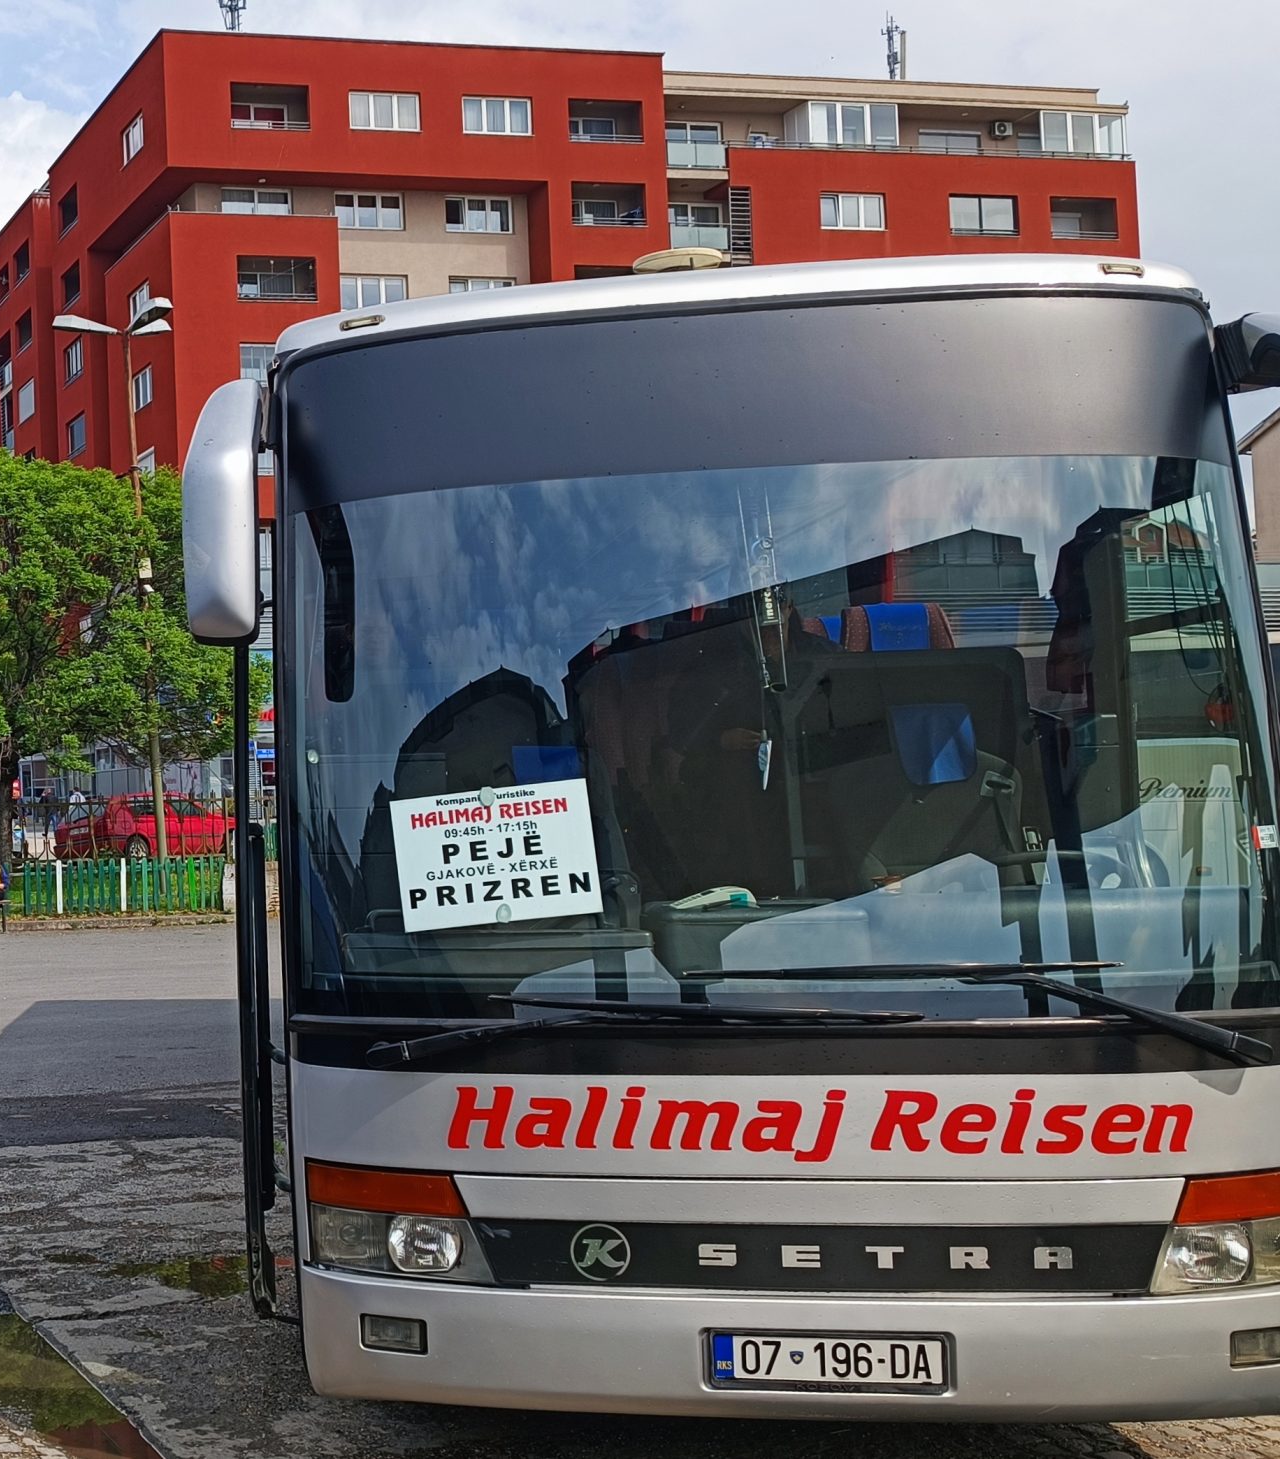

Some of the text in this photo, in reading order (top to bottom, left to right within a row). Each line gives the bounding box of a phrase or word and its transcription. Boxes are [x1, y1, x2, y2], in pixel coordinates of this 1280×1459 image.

[436, 794, 486, 806] Kompani
[1138, 777, 1232, 799] Premium
[410, 797, 568, 829] HALIMAJ REISEN
[444, 825, 485, 839] 09:45h
[496, 820, 538, 833] 17:15h
[441, 830, 543, 865] PEJË
[426, 862, 496, 881] GJAKOVË
[509, 856, 558, 873] XËRXË
[409, 871, 592, 909] PRIZREN
[447, 1086, 1194, 1163] Halimaj Reisen
[698, 1243, 1073, 1270] SETRA
[716, 1339, 932, 1380] RKS 07 196-DA
